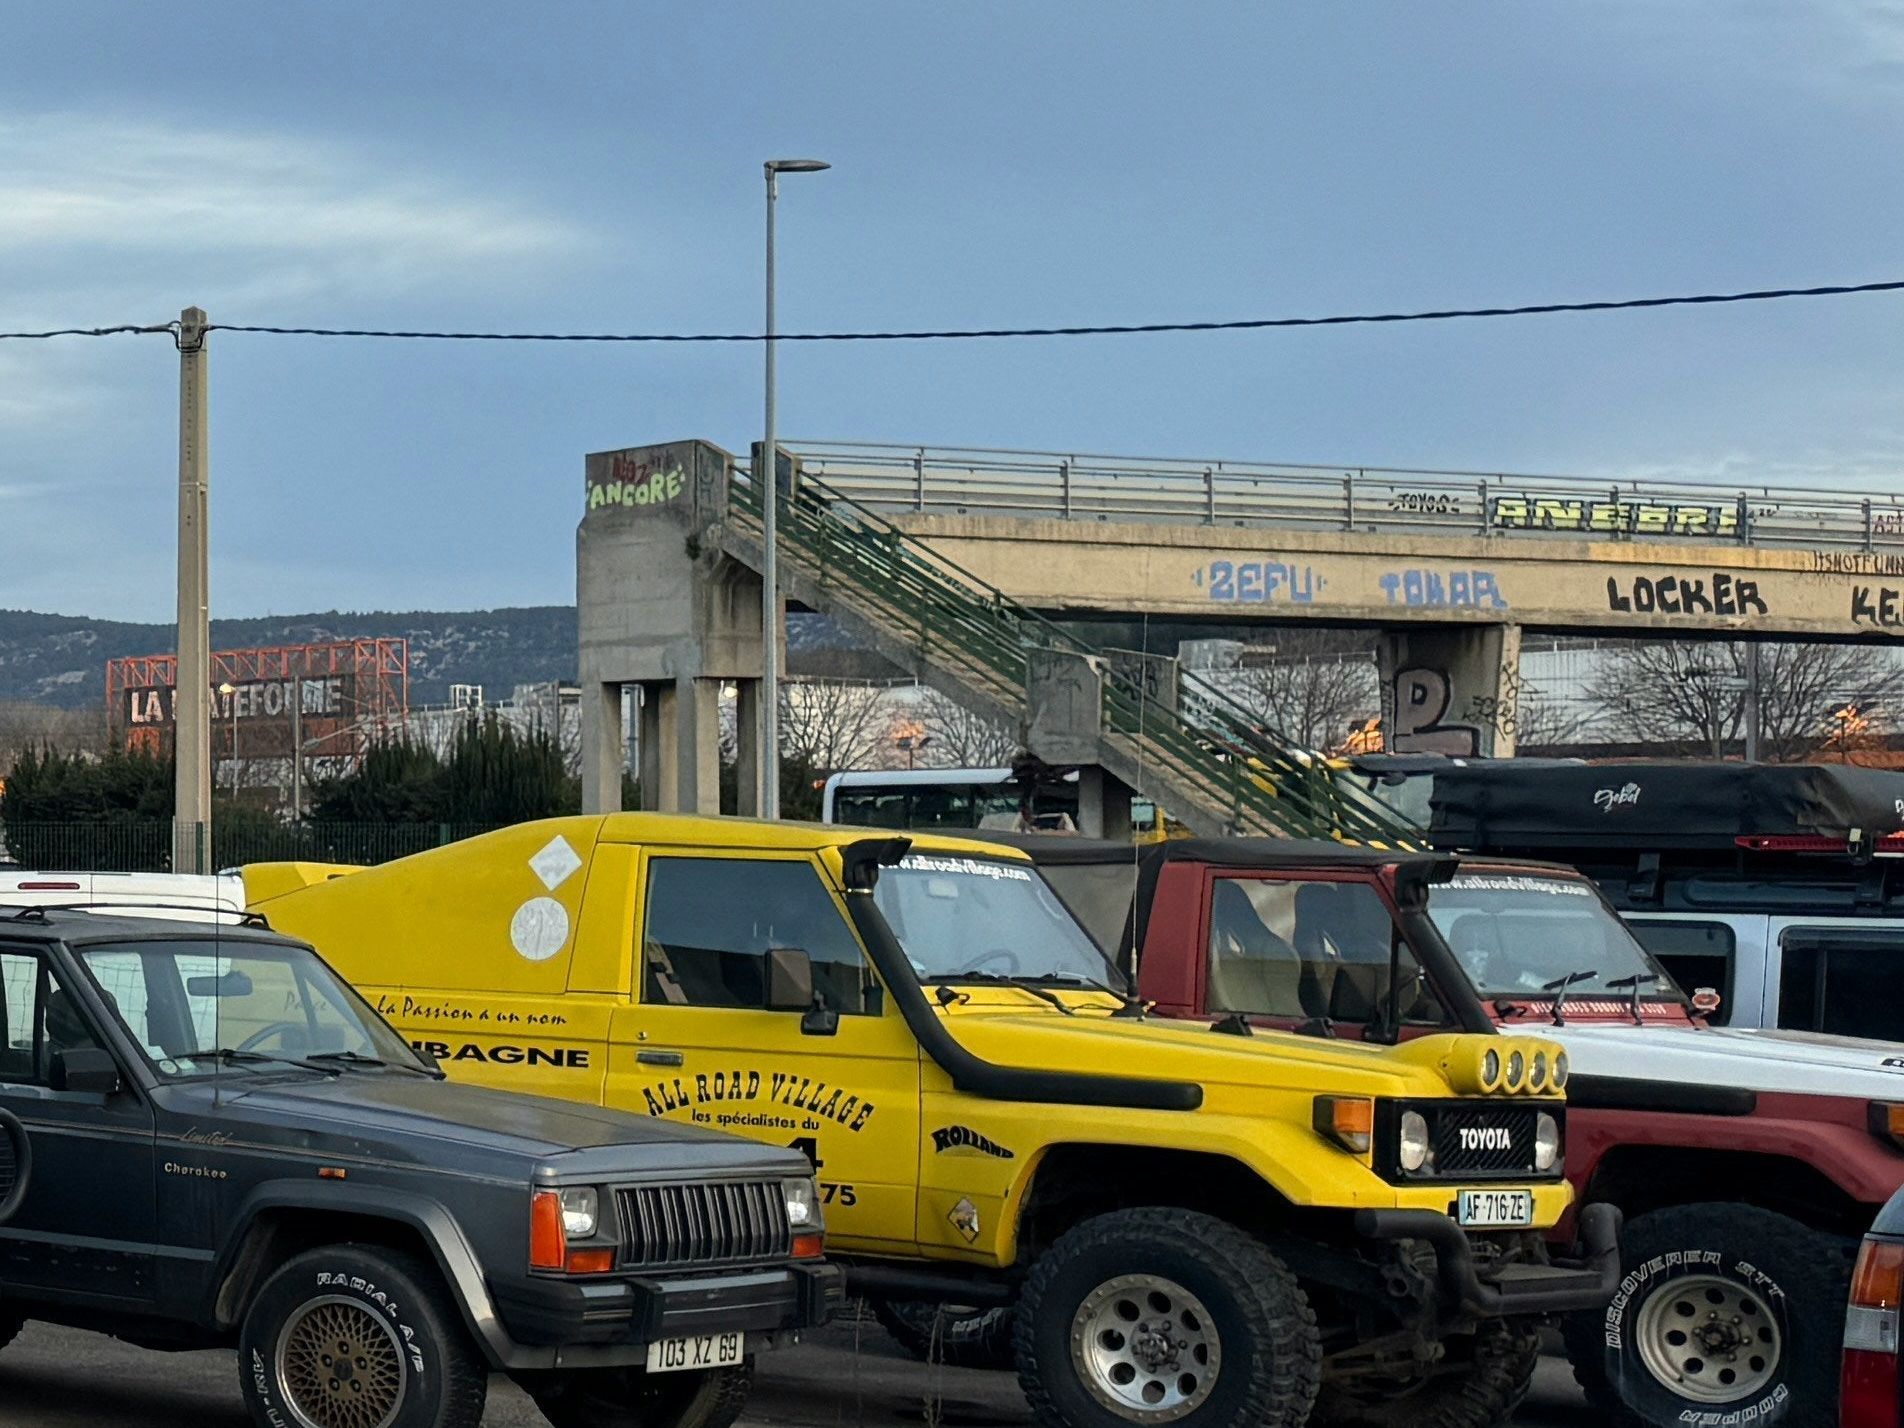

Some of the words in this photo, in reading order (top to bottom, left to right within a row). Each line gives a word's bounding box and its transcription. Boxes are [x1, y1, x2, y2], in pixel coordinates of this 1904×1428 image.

[1607, 573, 1768, 615] LOCKER
[1851, 585, 1904, 627] KE
[131, 690, 164, 723] LA
[377, 995, 395, 1014] La
[402, 996, 473, 1020] Passion
[526, 1013, 567, 1025] nom
[642, 1079, 690, 1117] ALL
[695, 1071, 760, 1103] ROAD
[692, 1109, 711, 1123] les
[716, 1110, 796, 1129] spécialistes
[801, 1117, 820, 1130] du
[1459, 1128, 1511, 1150] TOYOTA
[164, 1162, 227, 1179] Cherokee
[820, 1183, 857, 1207] 75
[317, 1272, 398, 1318] RADIAL
[1605, 1249, 1721, 1349] DISCOVERER
[1735, 1261, 1785, 1299] STT
[658, 1339, 686, 1368] 103
[693, 1337, 711, 1365] XZ
[719, 1334, 738, 1362] 69
[1678, 1383, 1789, 1425] COOPER
